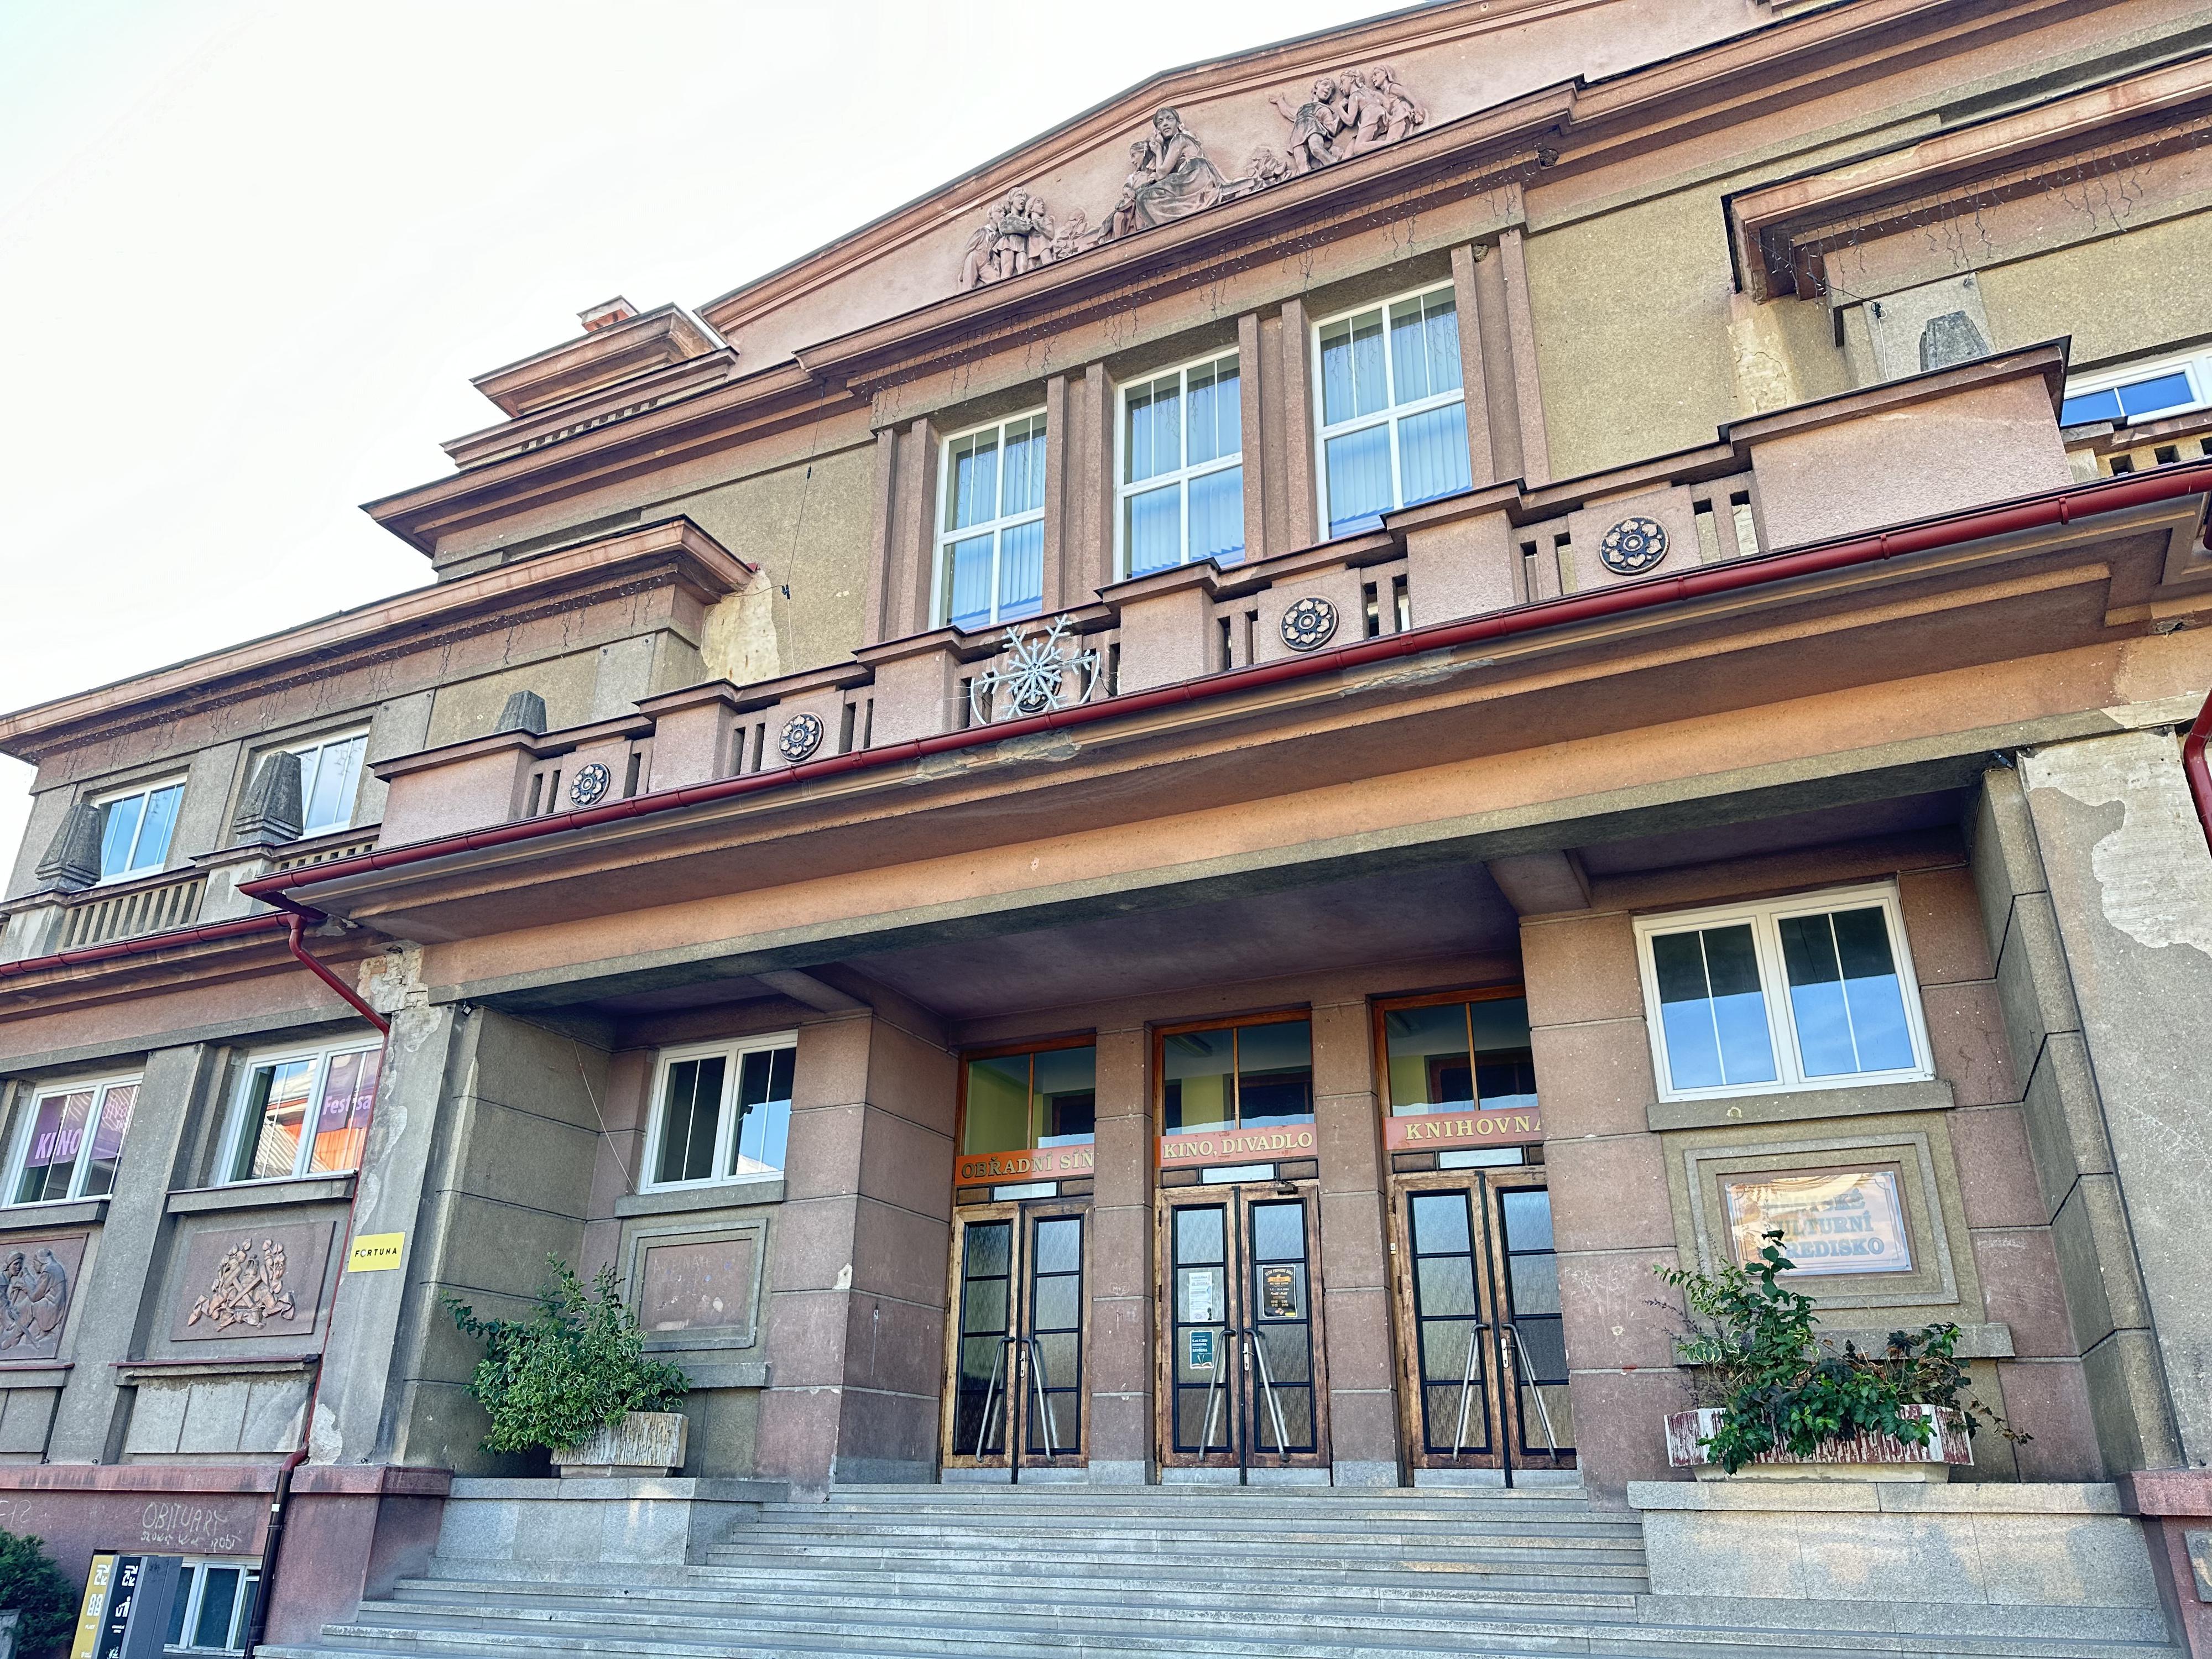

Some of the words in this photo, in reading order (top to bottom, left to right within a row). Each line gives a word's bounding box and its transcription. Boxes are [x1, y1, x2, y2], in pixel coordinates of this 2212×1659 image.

[35, 1128, 83, 1160] KINO
[1163, 1140, 1217, 1159] KINO,
[1221, 1132, 1313, 1154] DIVADLO
[962, 1151, 1053, 1179] OBŘADNÍ
[1059, 1147, 1094, 1170] SÍŇ
[354, 1247, 397, 1258] FORTUNA
